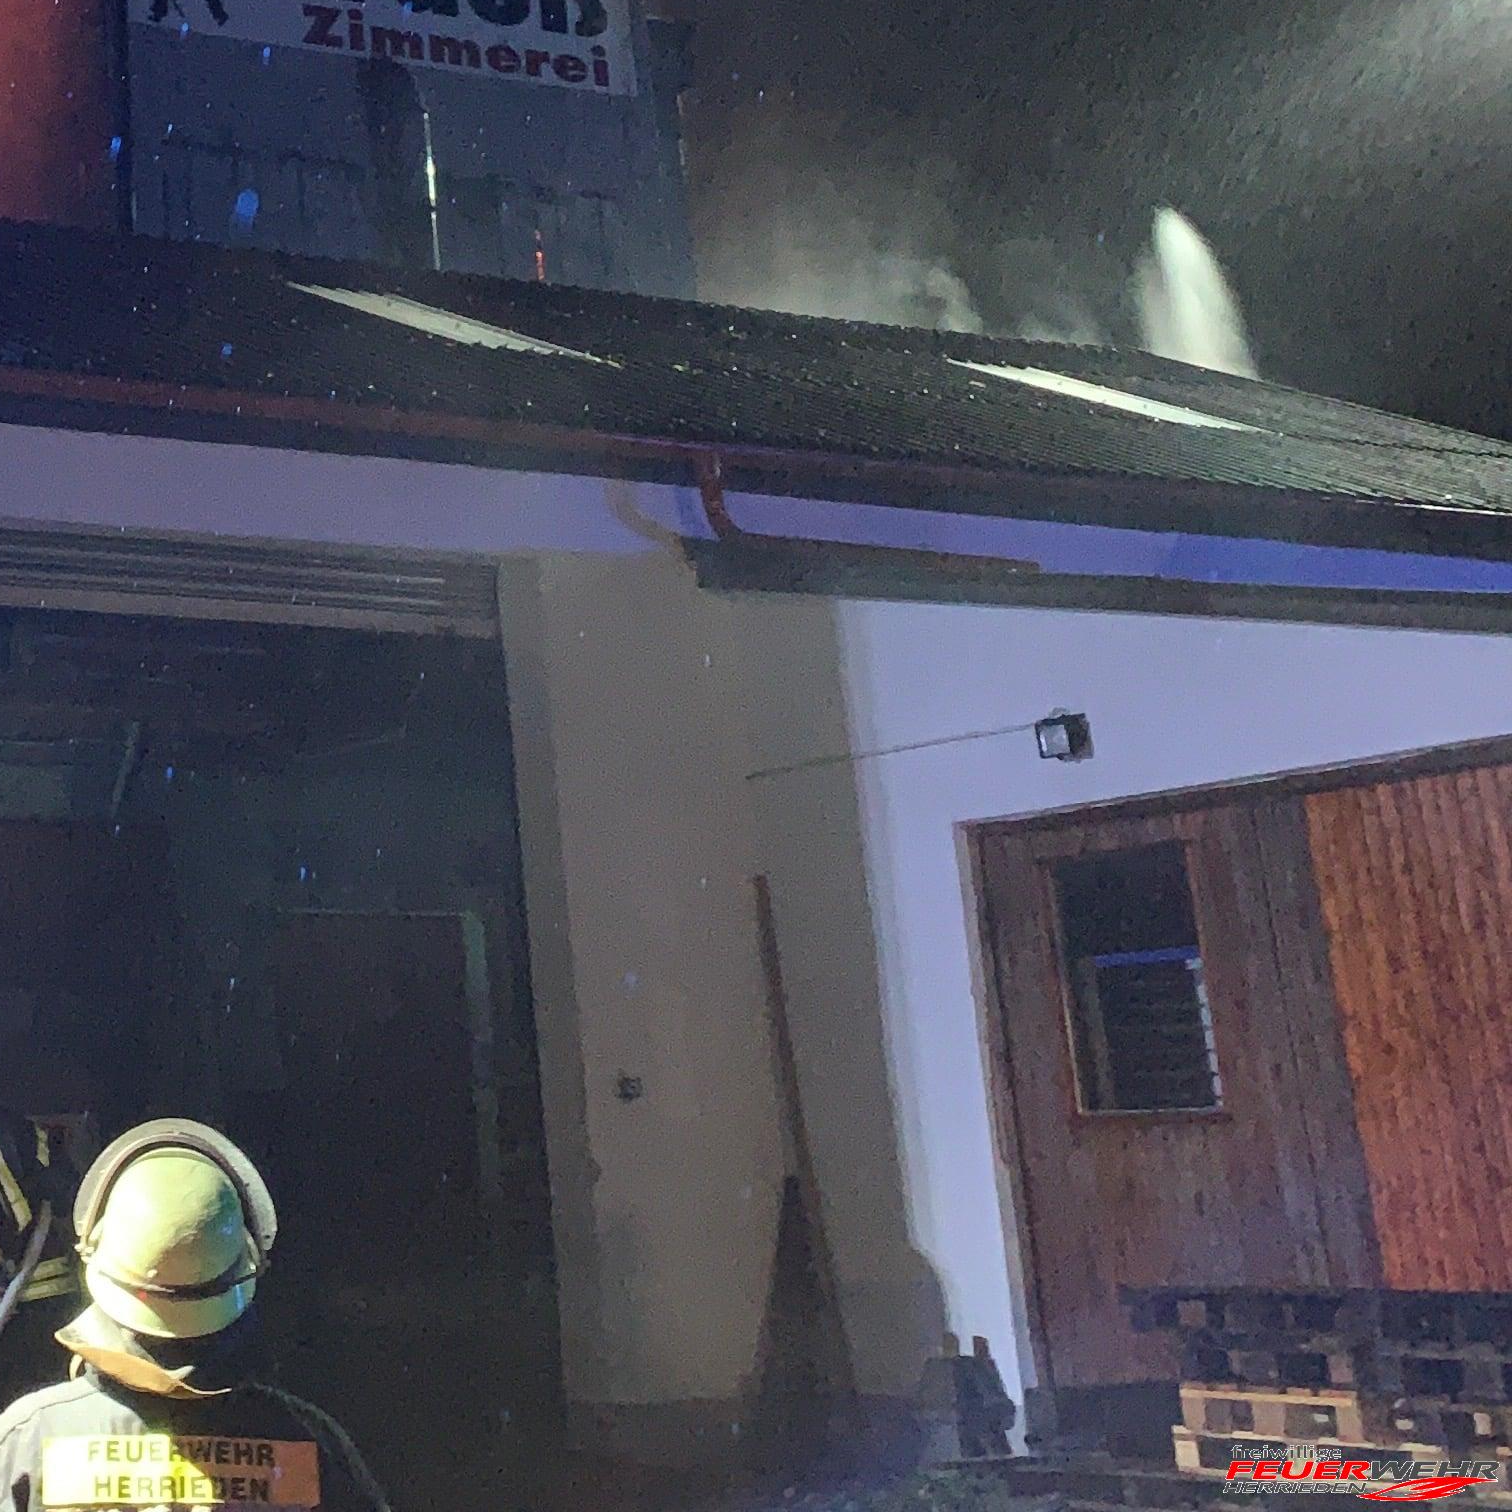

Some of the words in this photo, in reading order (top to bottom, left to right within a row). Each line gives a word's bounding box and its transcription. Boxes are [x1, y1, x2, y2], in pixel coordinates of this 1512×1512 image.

[302, 4, 610, 87] Zimmerei
[89, 1439, 276, 1467] FEUERWEHR
[94, 1474, 271, 1502] HERRIEDEN
